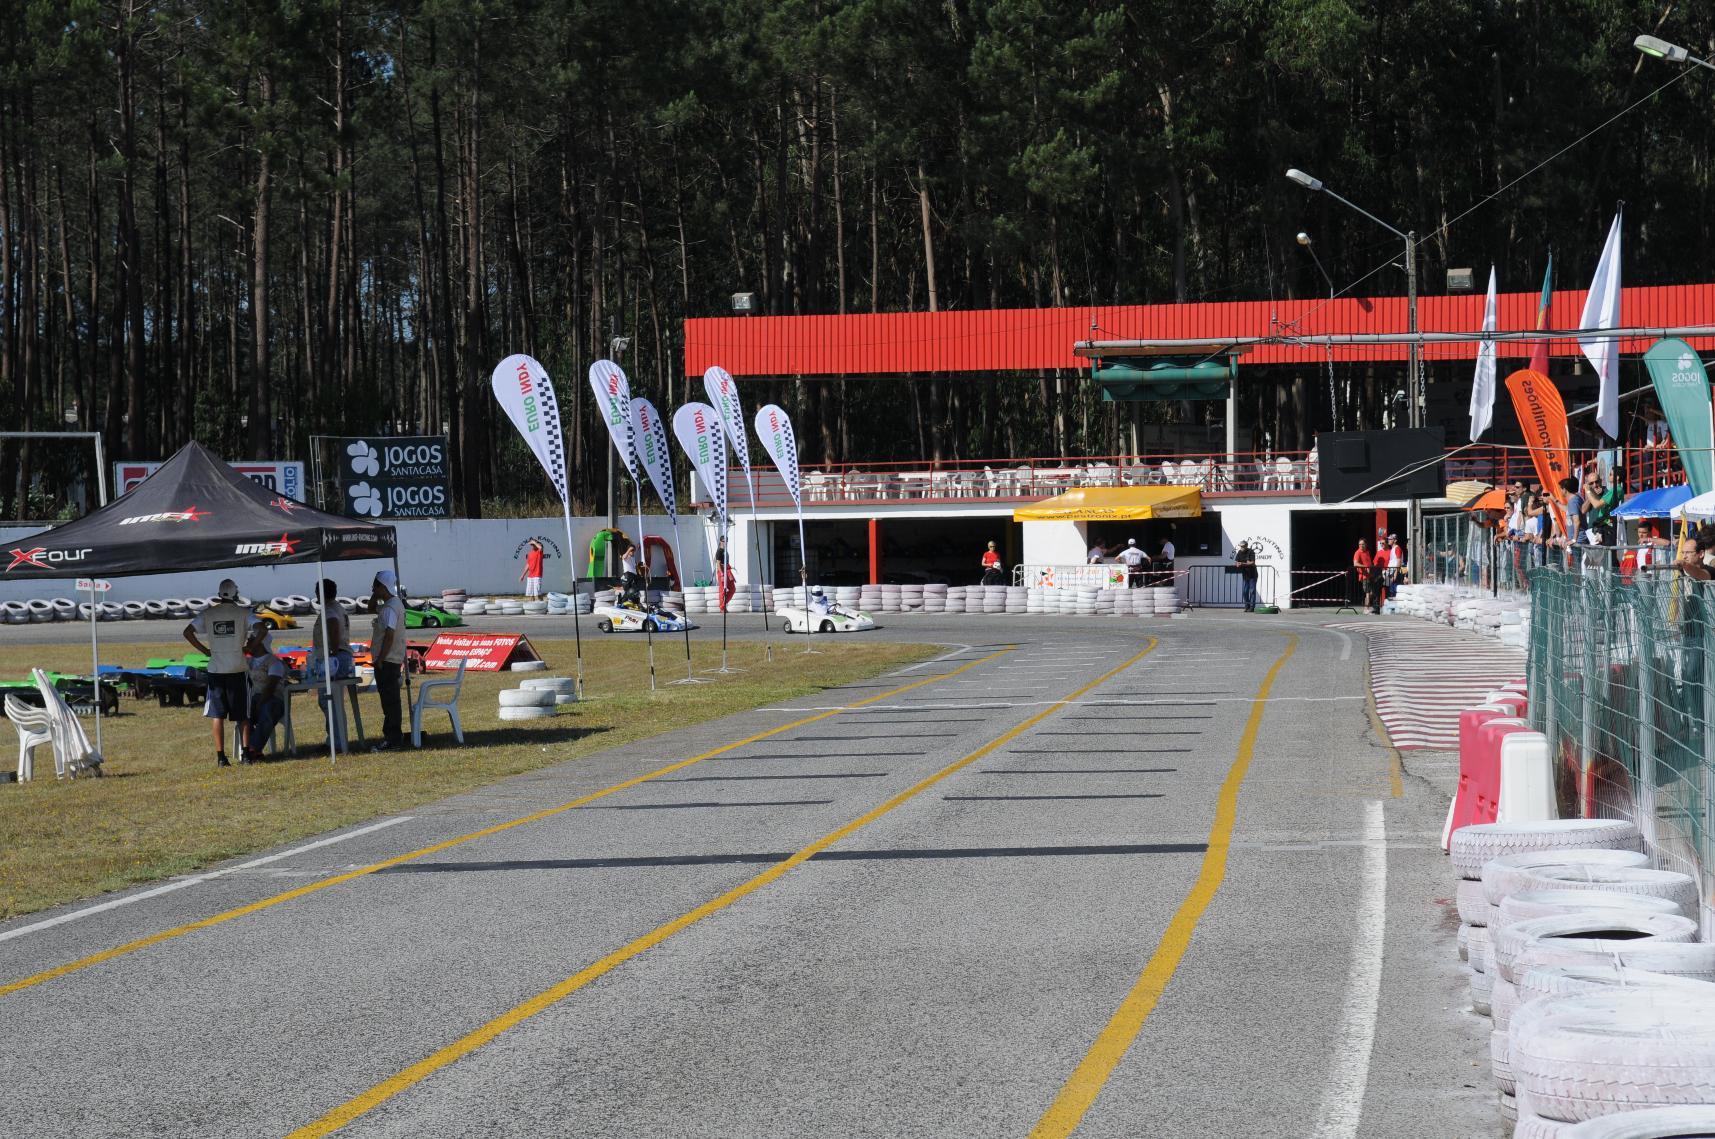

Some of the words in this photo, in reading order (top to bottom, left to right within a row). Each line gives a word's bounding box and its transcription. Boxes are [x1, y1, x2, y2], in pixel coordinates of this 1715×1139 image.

[384, 445, 442, 471] JOGOS
[387, 486, 445, 511] JOGOS
[394, 506, 445, 517] SANTACASA
[1256, 536, 1284, 560] KARTING
[436, 637, 453, 645] Venha
[493, 638, 515, 646] FOTOS
[469, 648, 493, 656] ESPAÇO
